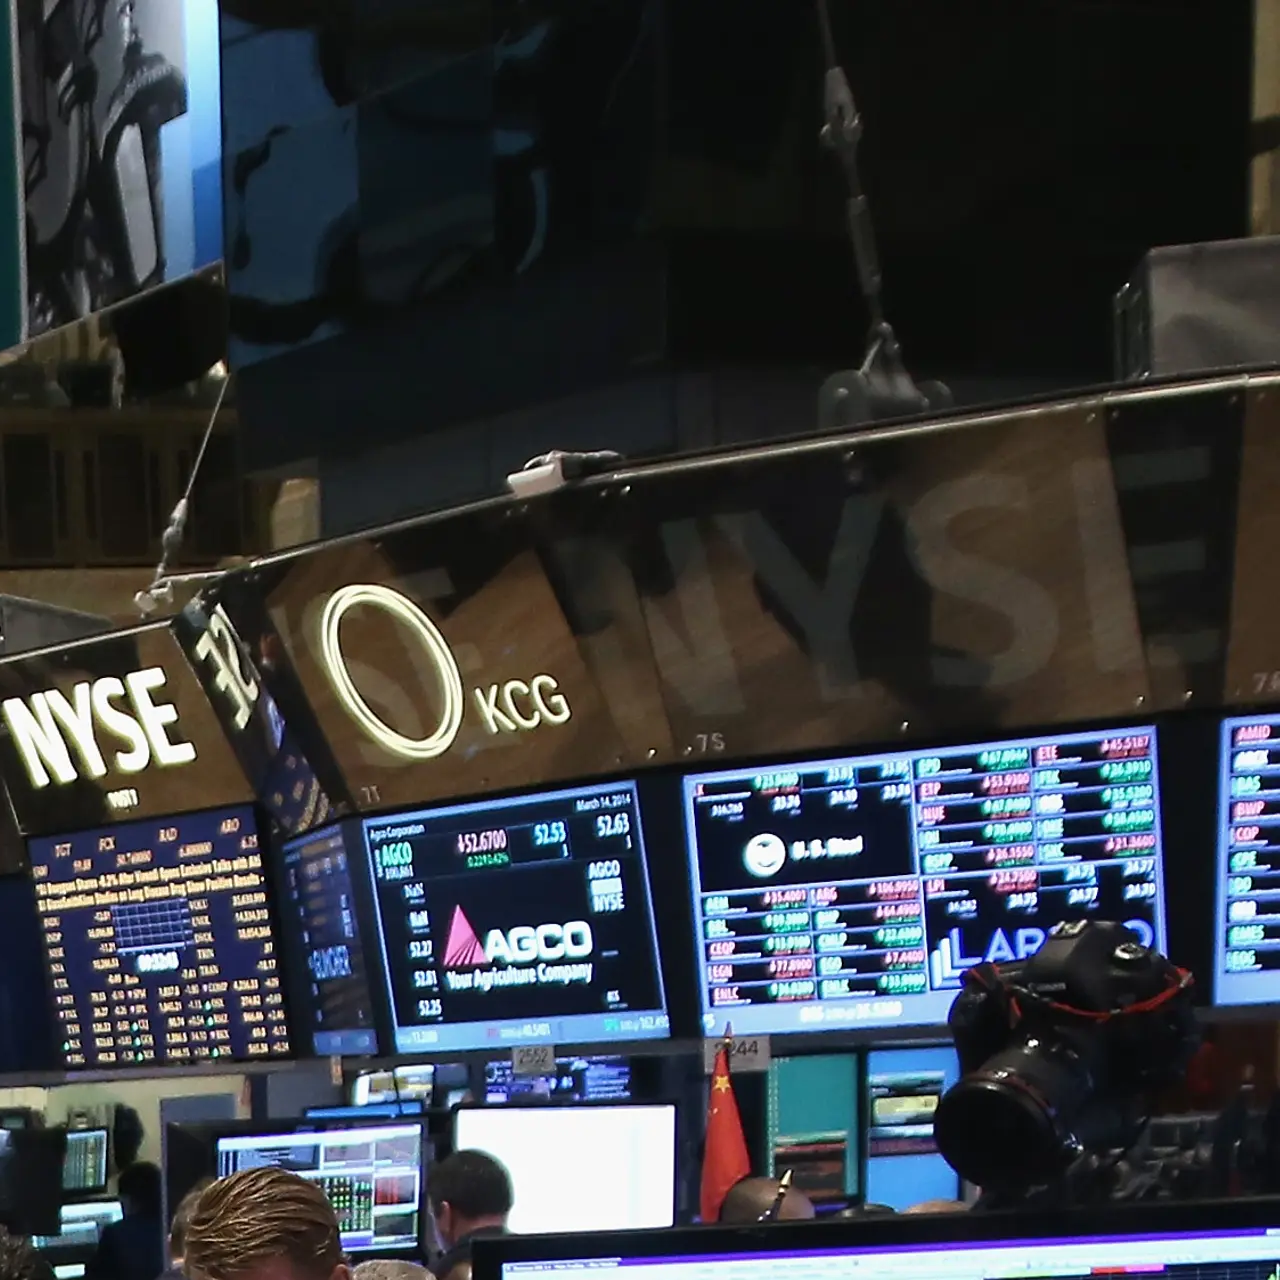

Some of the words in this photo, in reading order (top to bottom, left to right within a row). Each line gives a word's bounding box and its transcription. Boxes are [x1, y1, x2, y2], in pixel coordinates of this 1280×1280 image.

[474, 675, 572, 734] KCG
[1, 666, 197, 789] NYSE
[696, 732, 725, 752] 7S
[382, 842, 412, 866] AGCO
[465, 829, 506, 852] 52.6700
[534, 822, 566, 845] 52.53
[597, 813, 629, 836] 52.63
[589, 860, 620, 879] AGCO
[592, 892, 625, 912] NYSE
[485, 921, 592, 963] AGCO
[446, 971, 472, 990] Your
[474, 967, 536, 992] Agriculture
[538, 963, 592, 986] Company
